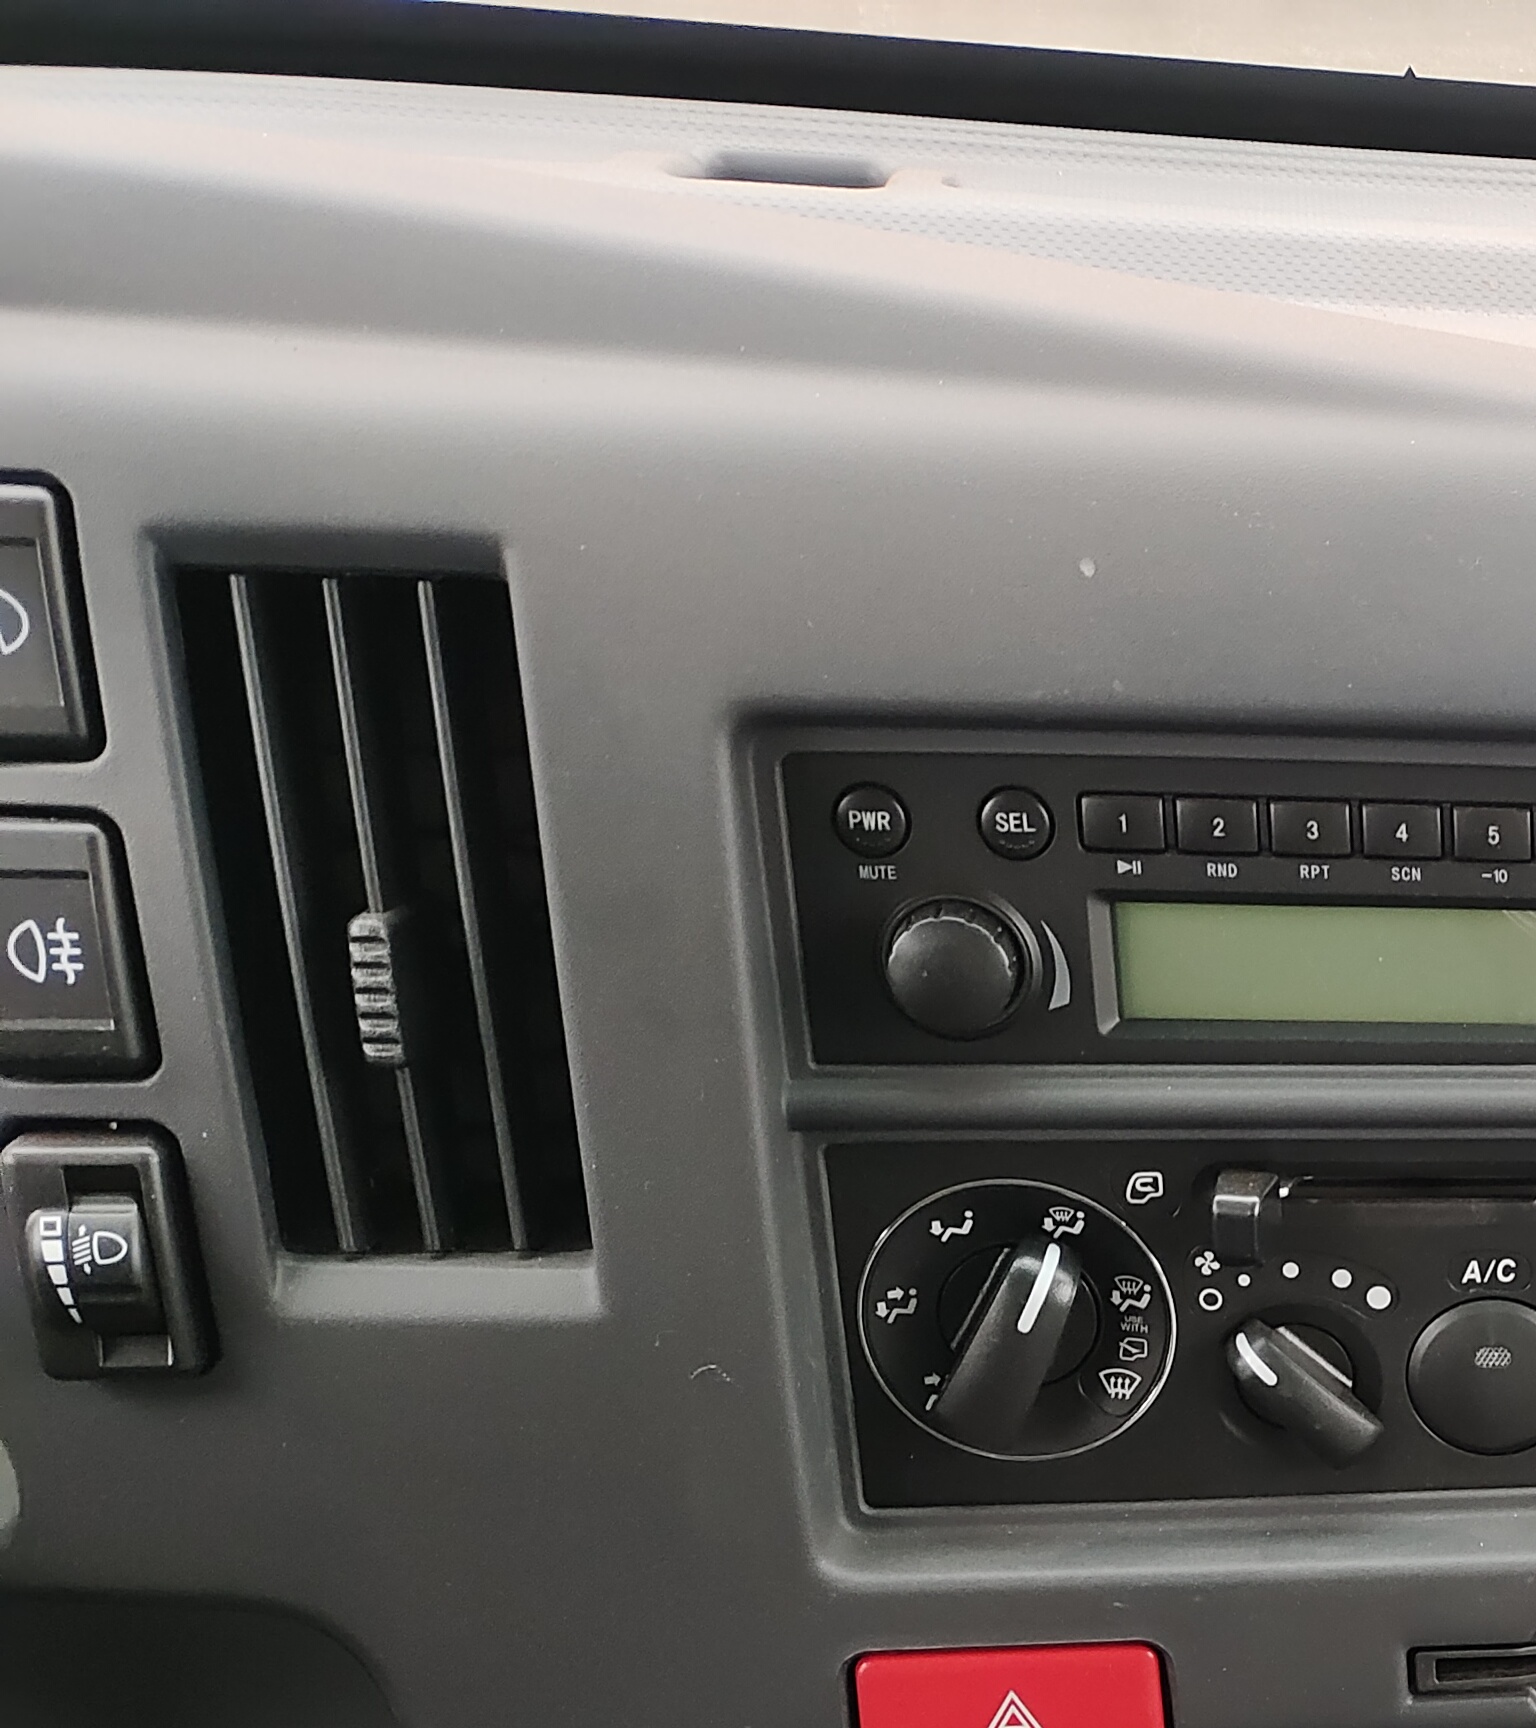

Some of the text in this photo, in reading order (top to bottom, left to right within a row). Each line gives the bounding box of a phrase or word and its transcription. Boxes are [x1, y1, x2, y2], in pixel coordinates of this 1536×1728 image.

[848, 810, 891, 830] PWR
[995, 812, 1036, 832] SEL
[1118, 813, 1128, 833] 1
[1213, 817, 1226, 837] 2
[1306, 820, 1320, 840] 3
[1395, 822, 1409, 842] 4
[1487, 825, 1500, 845] 5
[858, 865, 897, 881] MUTE
[1206, 862, 1238, 879] RND
[1300, 864, 1330, 880] RPT
[1391, 866, 1422, 882] SCN
[1461, 1259, 1517, 1284] A/C
[1121, 1321, 1148, 1334] WITH
